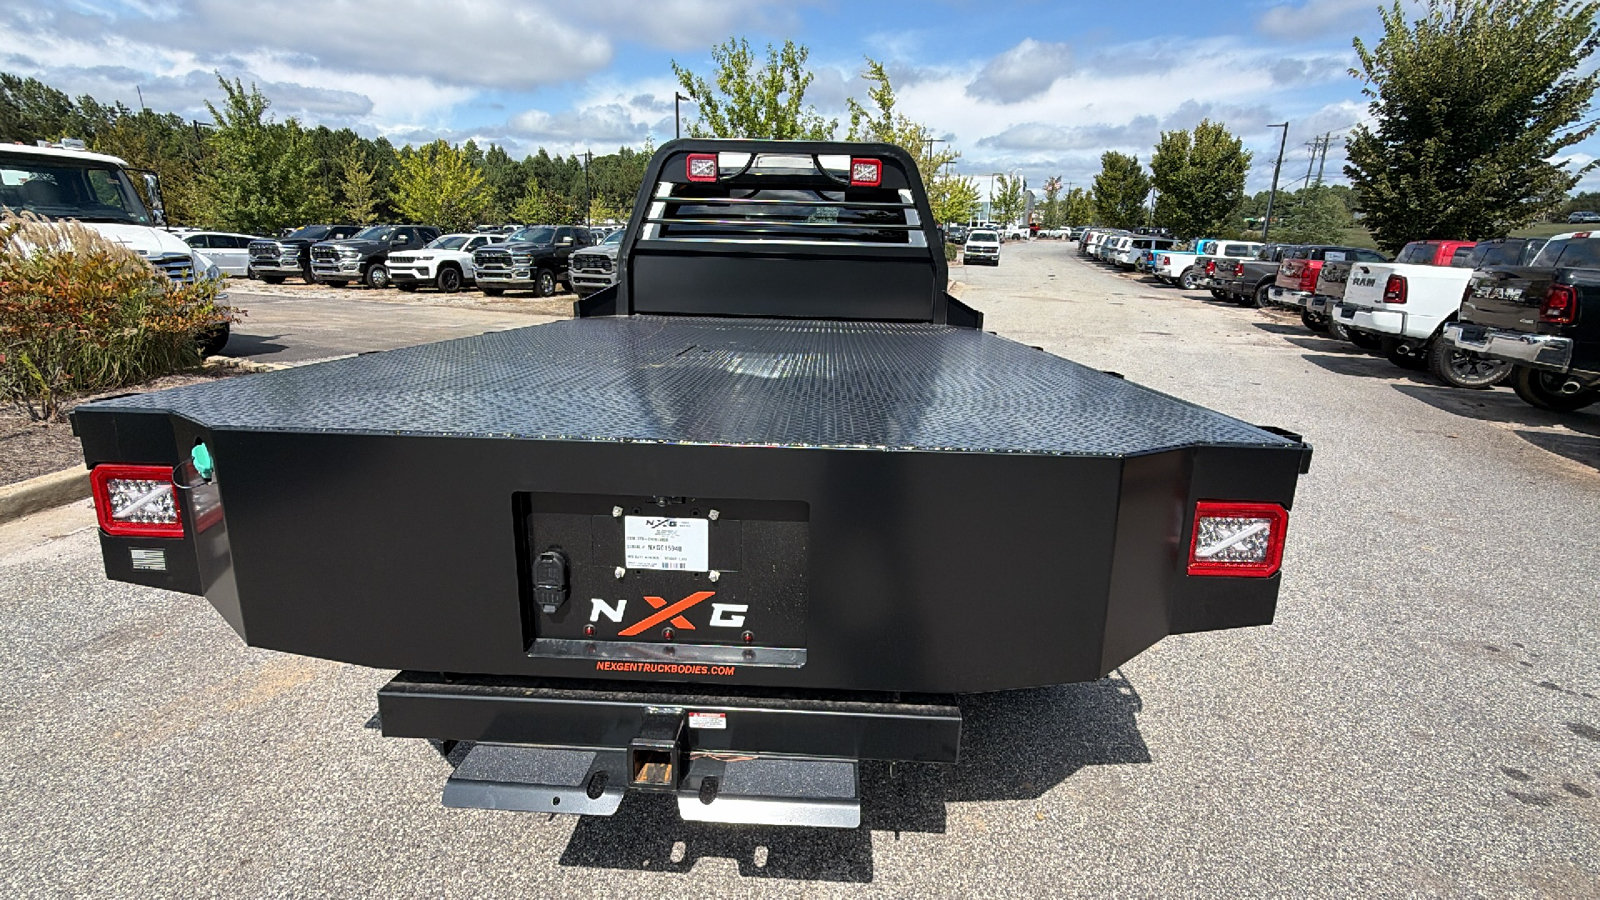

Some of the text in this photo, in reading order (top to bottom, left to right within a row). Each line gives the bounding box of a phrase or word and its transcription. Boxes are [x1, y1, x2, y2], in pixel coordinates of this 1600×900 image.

[1352, 277, 1376, 288] RAM
[645, 519, 678, 529] NXG
[589, 591, 749, 636] NXG
[596, 661, 735, 676] NEXGENTRUCKBODIES.COM
